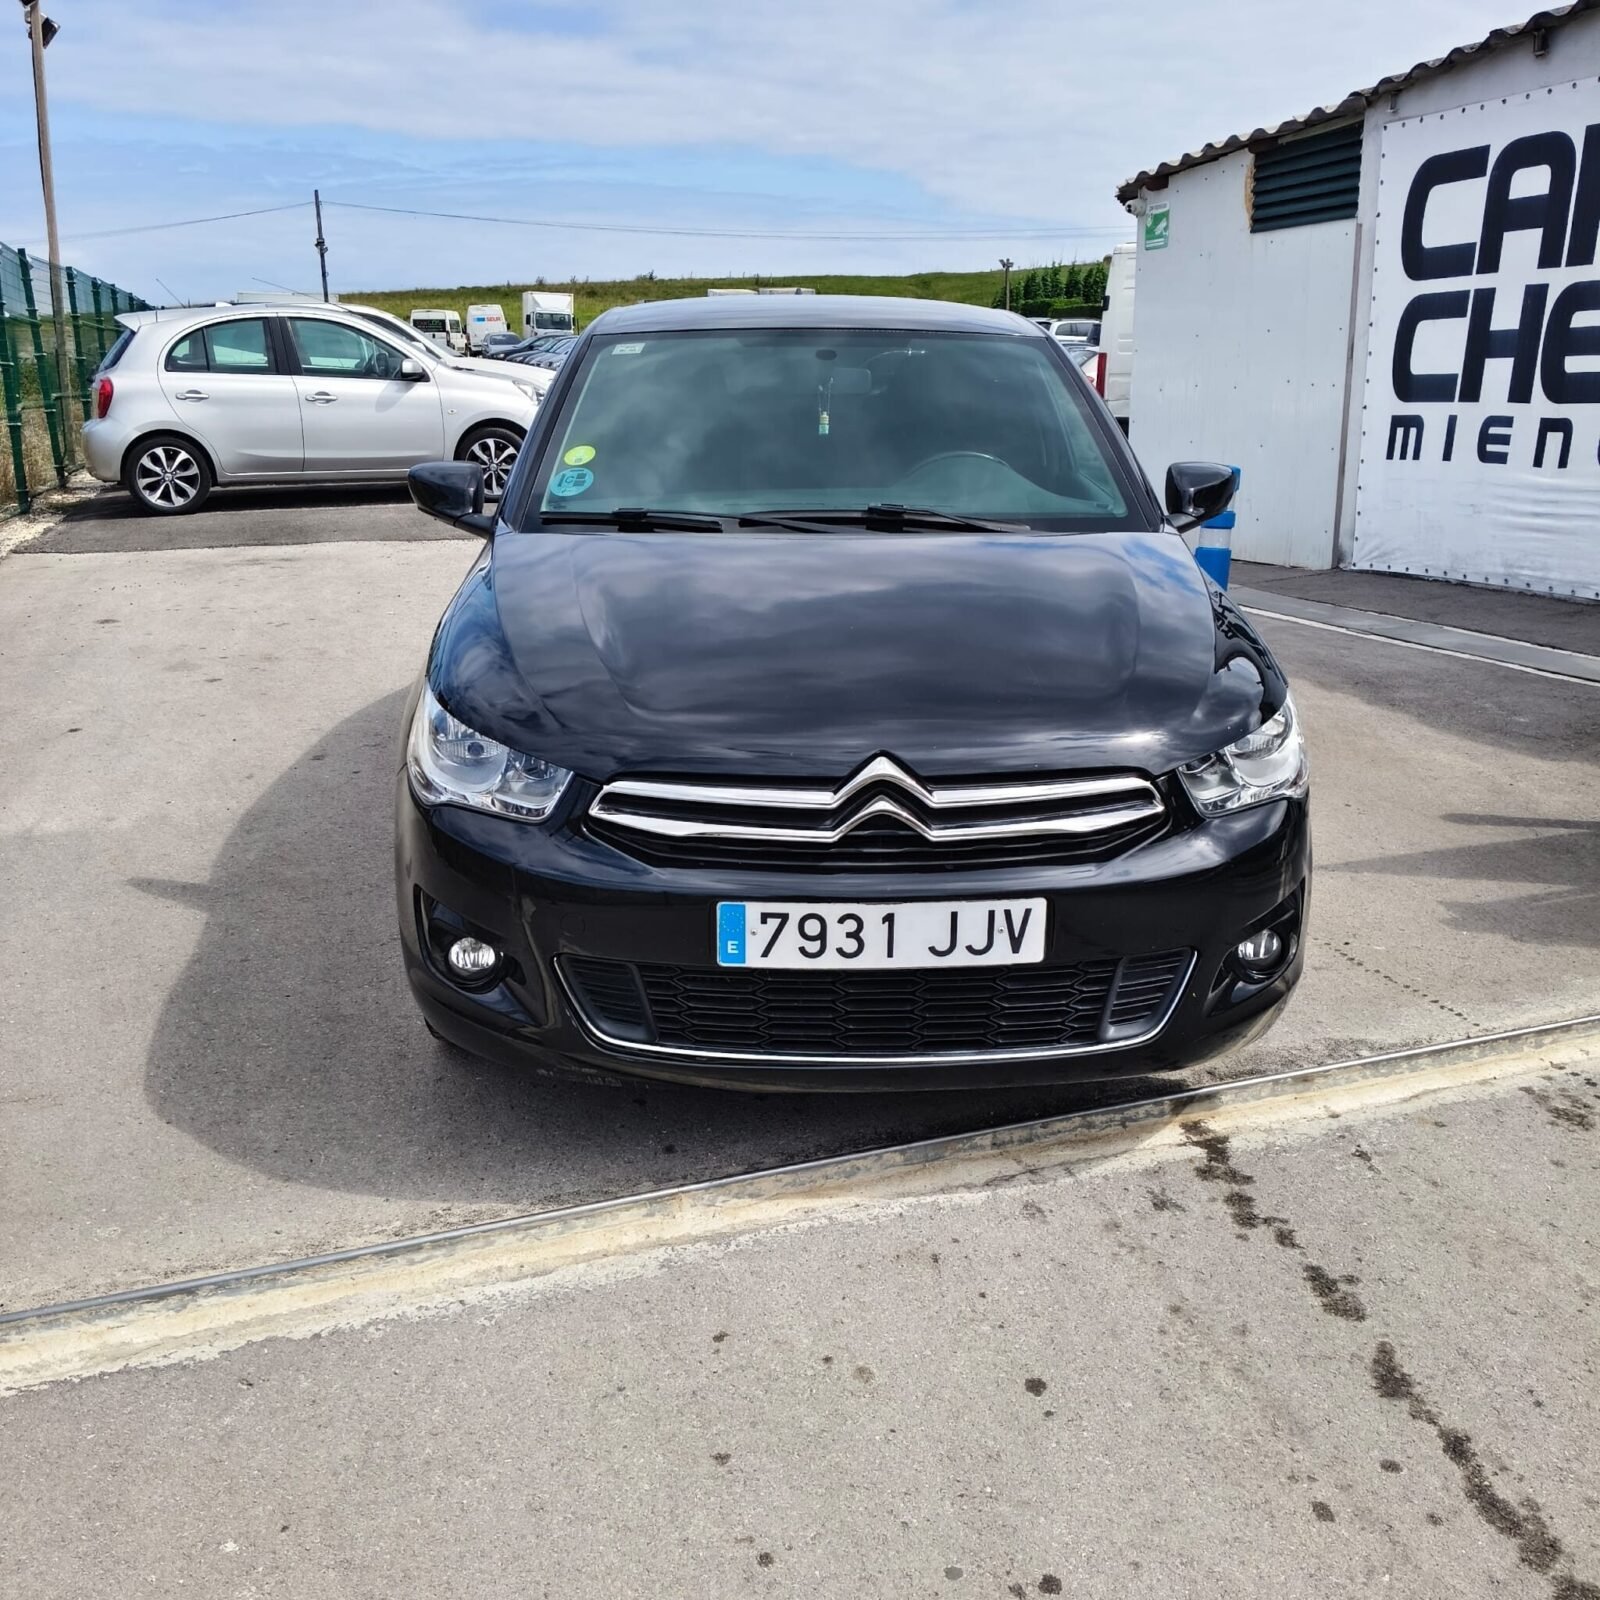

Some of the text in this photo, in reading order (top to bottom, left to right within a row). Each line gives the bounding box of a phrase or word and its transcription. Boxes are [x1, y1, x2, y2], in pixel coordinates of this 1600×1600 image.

[1386, 414, 1600, 469] MIEN
[727, 941, 738, 953] E
[760, 908, 1032, 959] 7931 JJV
